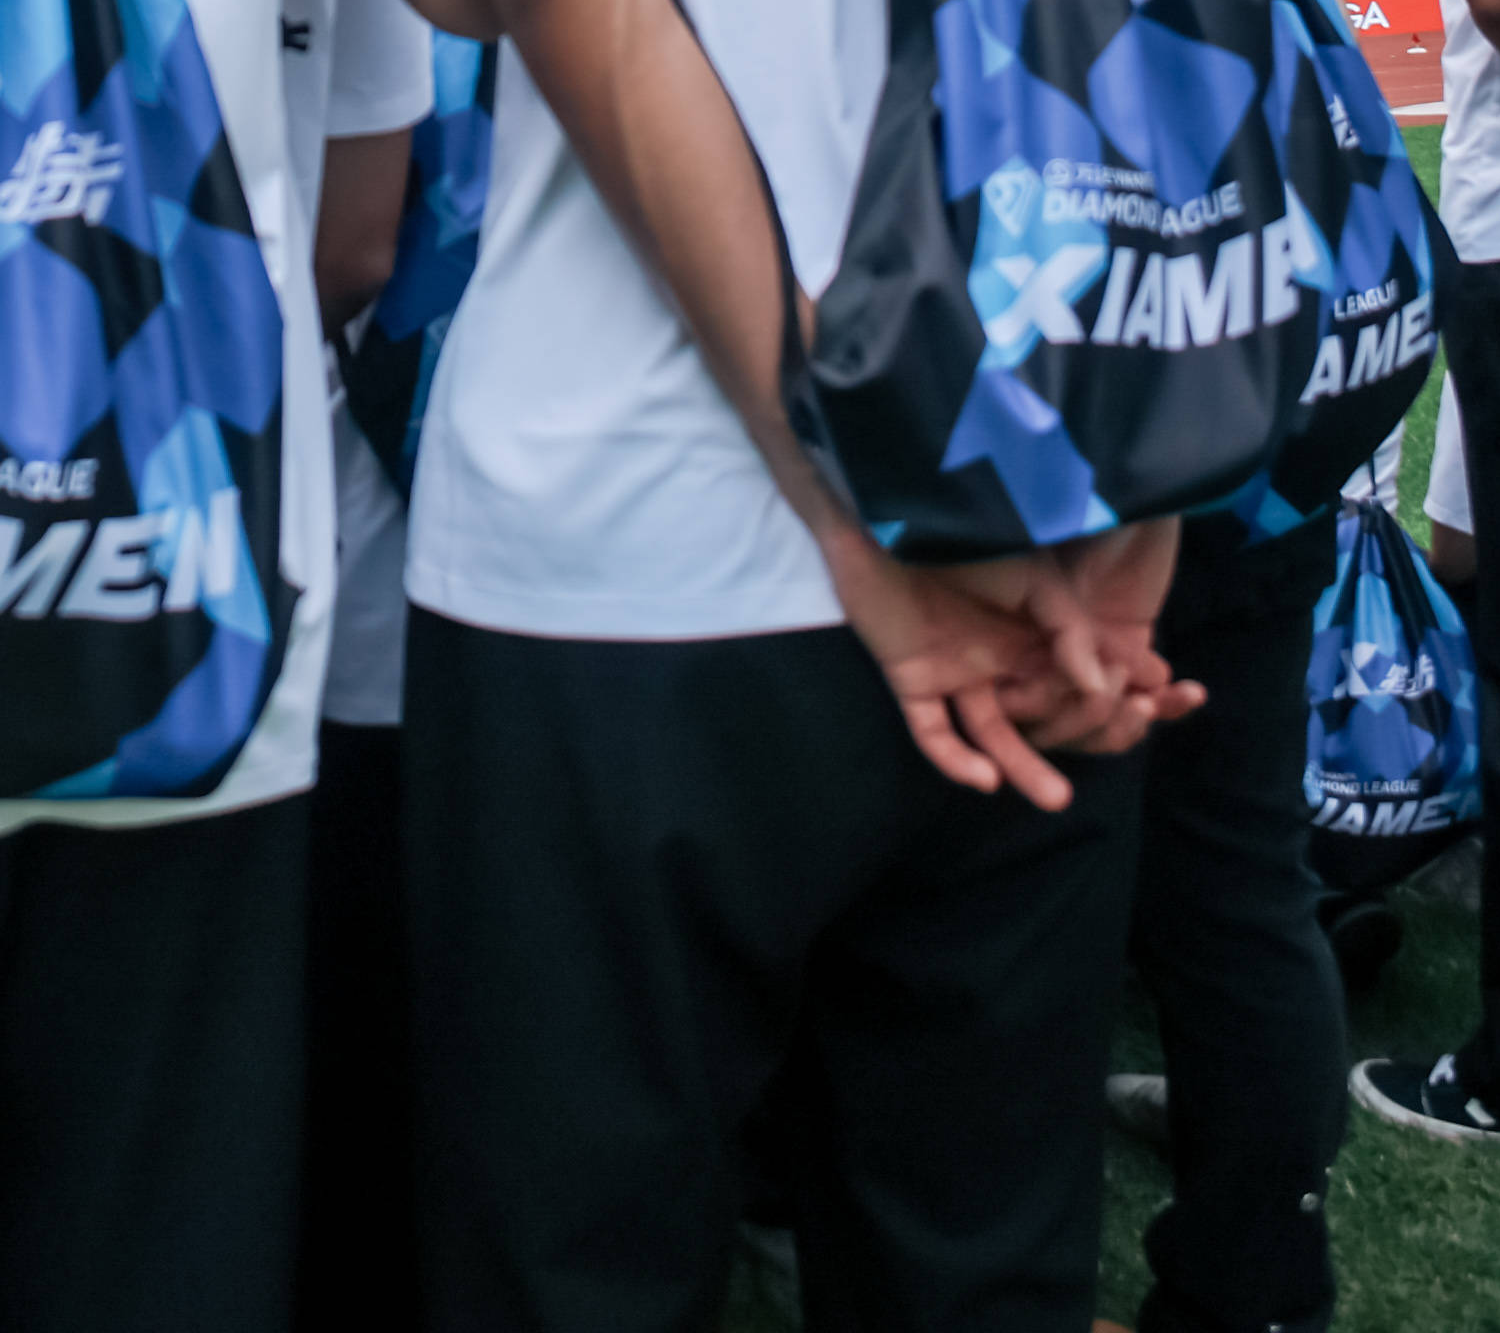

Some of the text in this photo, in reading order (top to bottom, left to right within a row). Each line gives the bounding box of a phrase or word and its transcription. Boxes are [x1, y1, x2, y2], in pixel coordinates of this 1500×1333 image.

[1160, 180, 1243, 237] AGUE
[1334, 278, 1399, 320] LEAGU
[1363, 778, 1422, 794] LEAGUE
